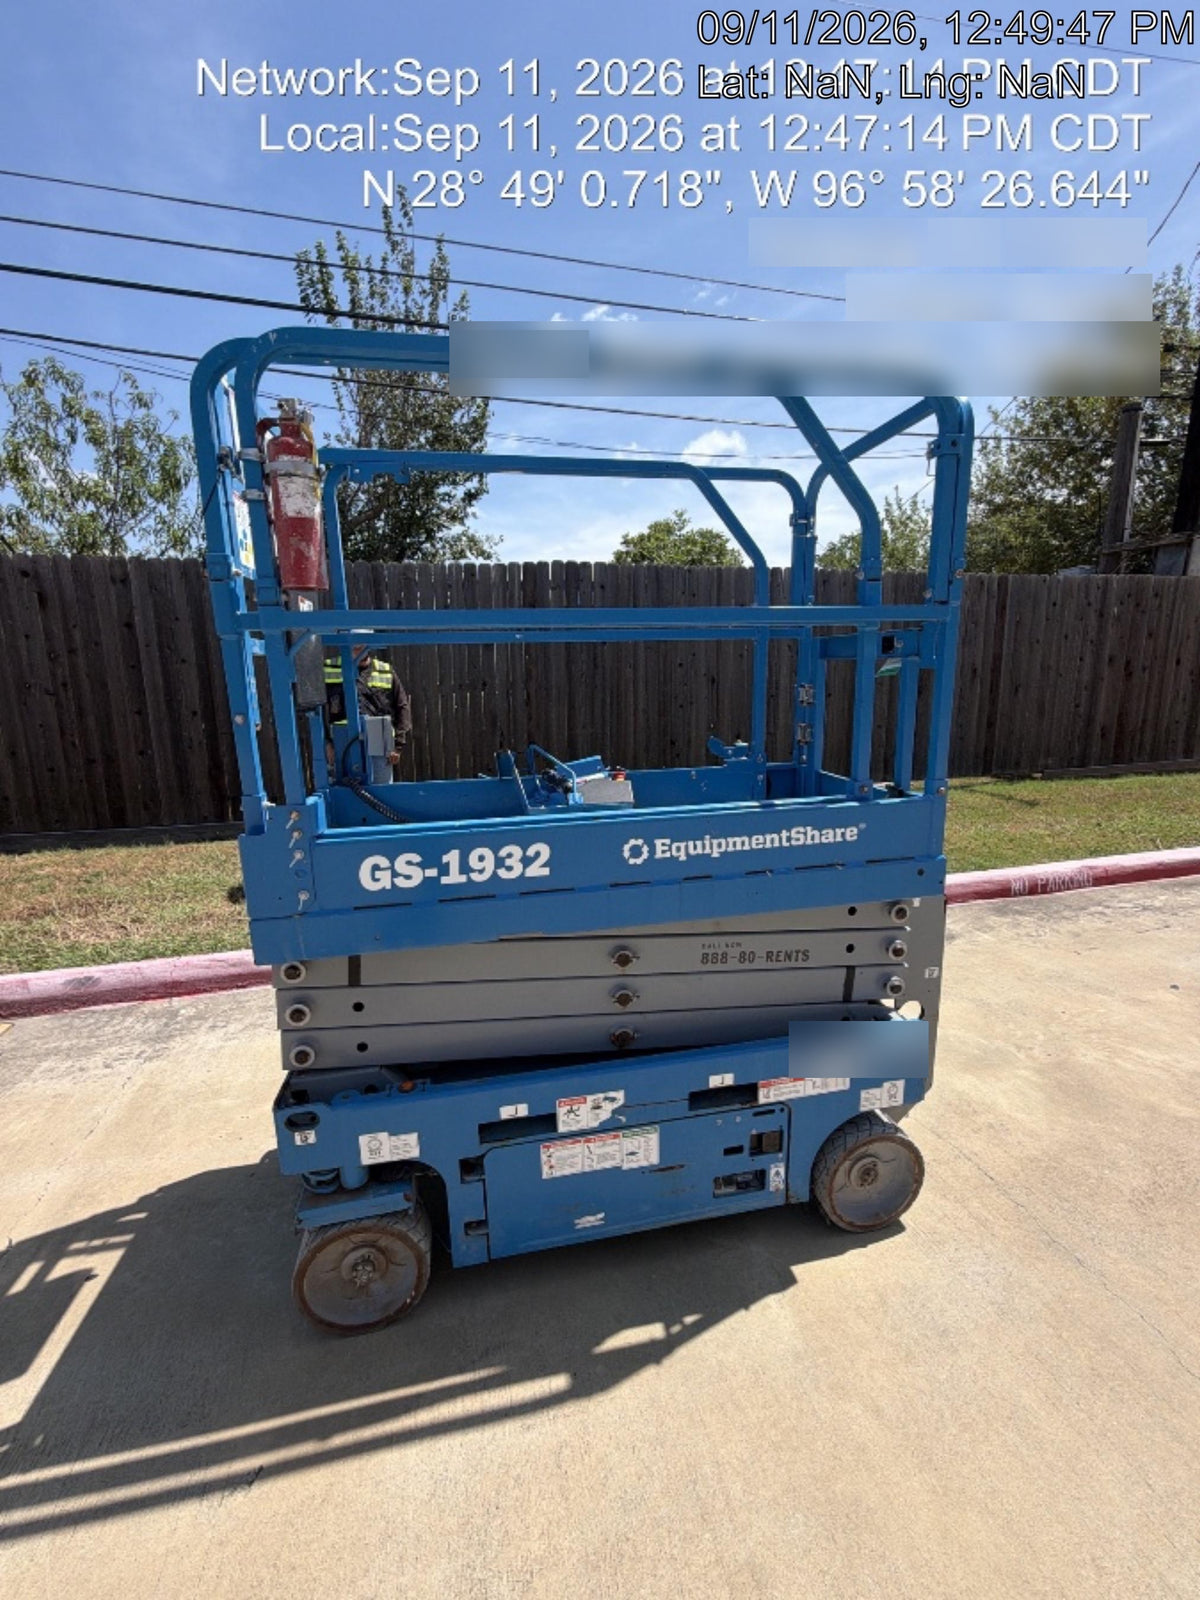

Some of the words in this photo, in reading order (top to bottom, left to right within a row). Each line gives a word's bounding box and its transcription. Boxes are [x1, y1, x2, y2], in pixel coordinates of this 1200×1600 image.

[654, 825, 858, 861] EquipmentShare
[358, 842, 551, 892] GS-1932
[701, 948, 810, 965] 888-80-RENTS
